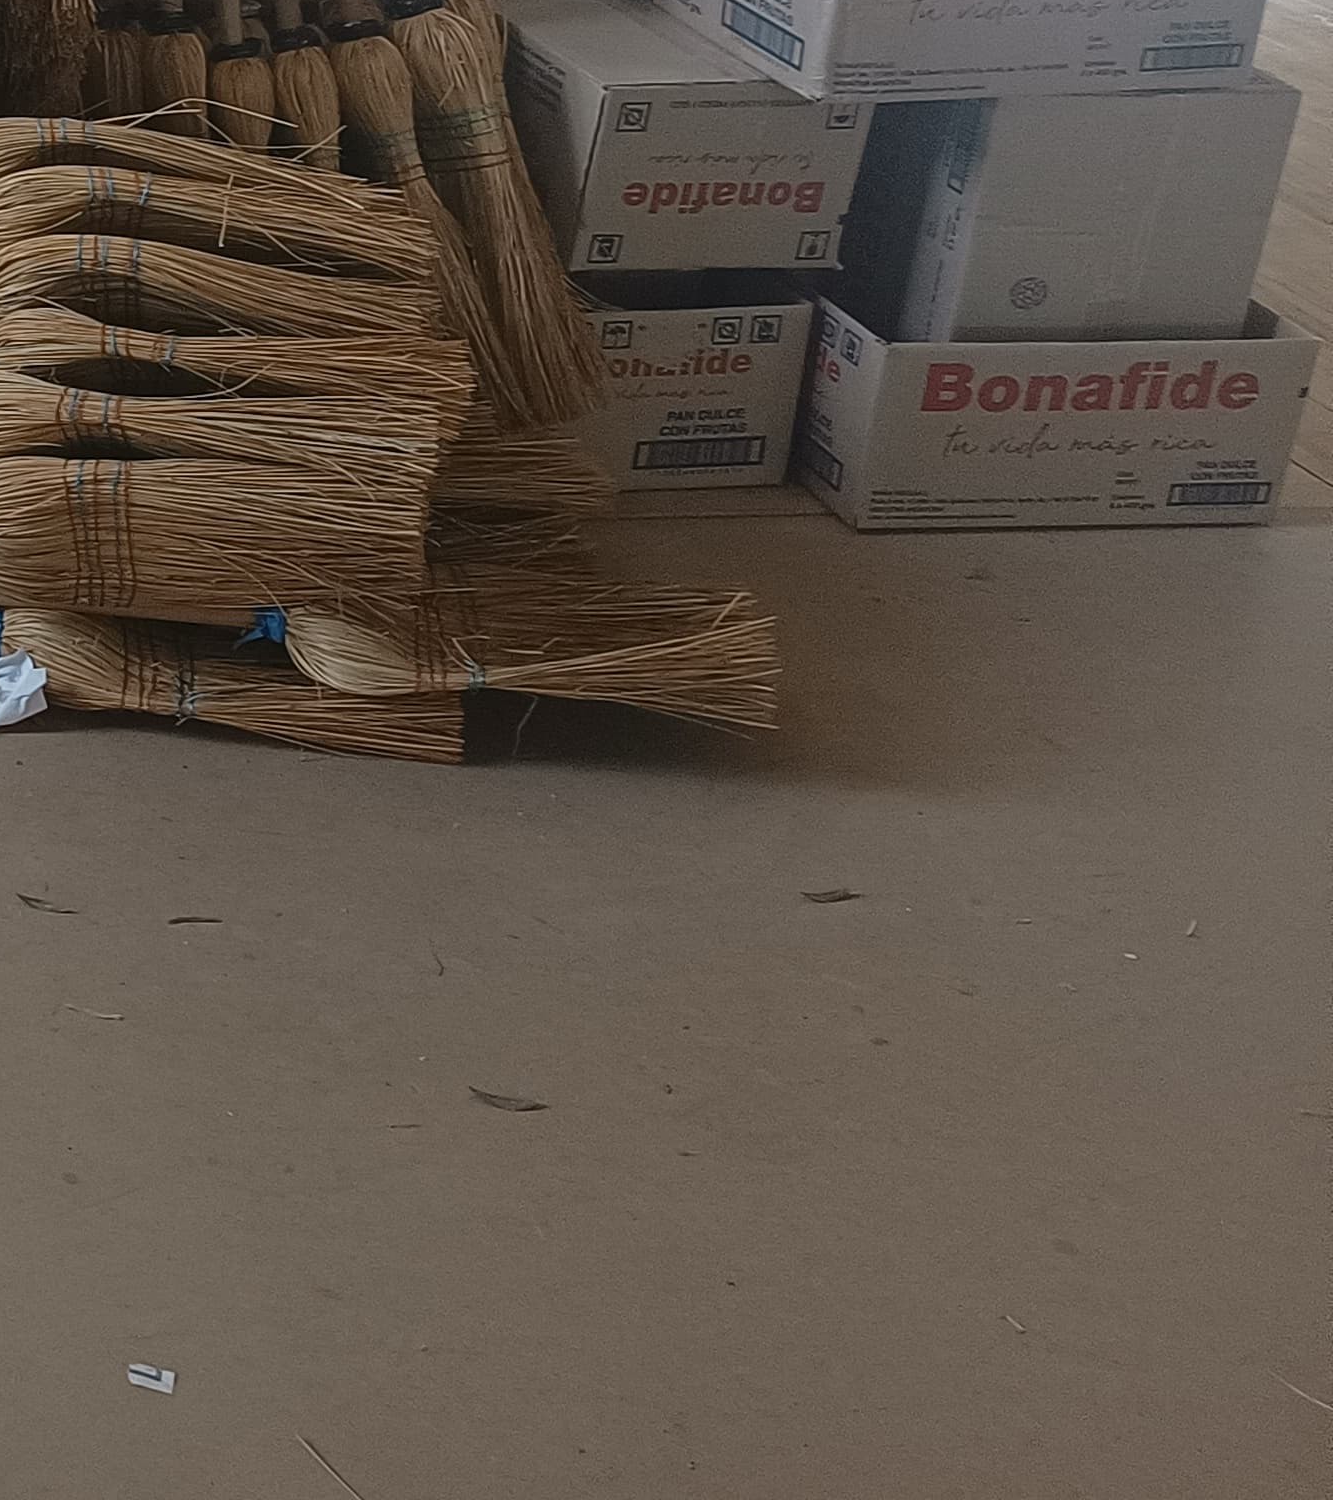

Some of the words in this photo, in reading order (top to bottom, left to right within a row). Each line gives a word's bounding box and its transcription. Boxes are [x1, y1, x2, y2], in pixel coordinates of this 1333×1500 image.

[622, 181, 826, 215] Bonafide
[921, 359, 1261, 413] Bonafide
[989, 422, 1060, 459] vida
[1151, 434, 1217, 451] rica
